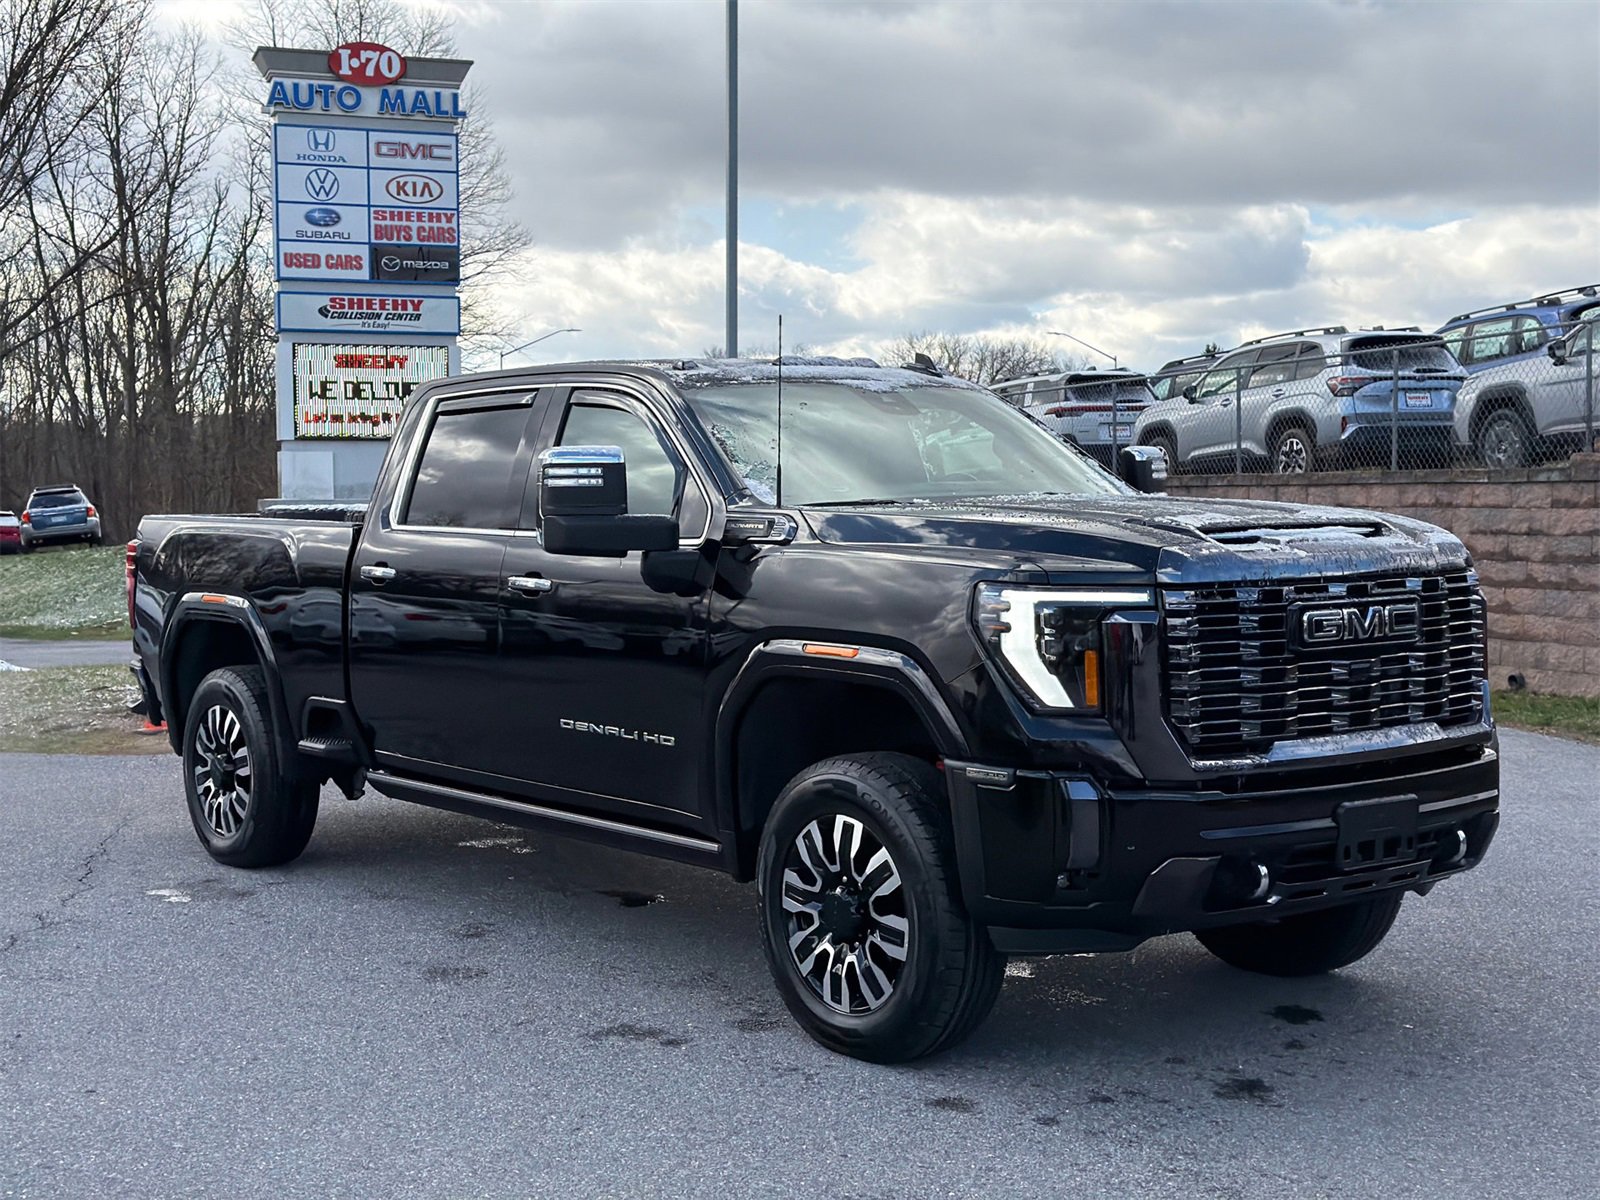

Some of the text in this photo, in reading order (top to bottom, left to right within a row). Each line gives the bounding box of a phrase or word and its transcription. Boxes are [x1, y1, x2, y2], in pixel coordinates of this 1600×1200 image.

[266, 81, 467, 118] AUTO MALL
[296, 153, 347, 163] HONDA
[375, 141, 452, 161] GMC
[396, 181, 434, 198] KIA
[372, 209, 456, 224] SHEEHY
[295, 230, 351, 240] SUBARU
[373, 224, 457, 244] BUYS CARS
[283, 252, 364, 271] USED CARS
[329, 297, 424, 312] SHEEHY
[329, 310, 422, 322] COLLISION CENTER
[1302, 603, 1419, 643] GMC
[560, 718, 675, 746] DENALI HD
